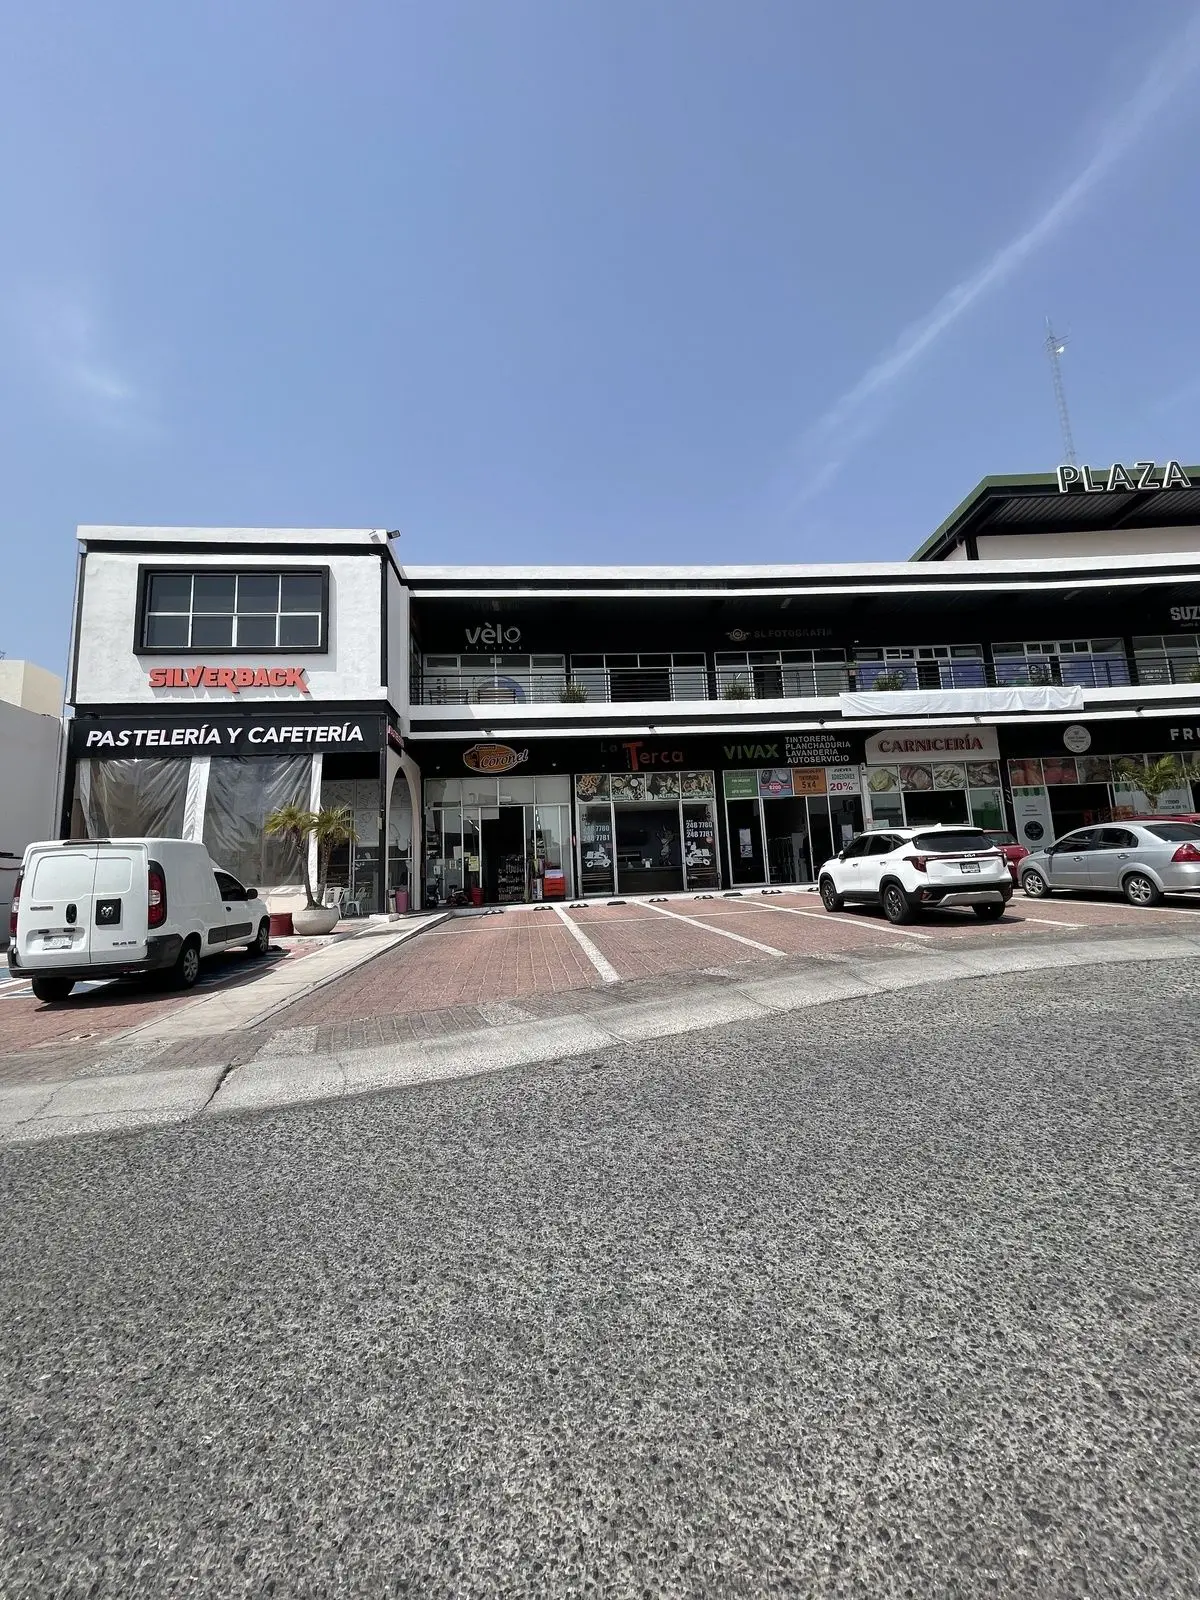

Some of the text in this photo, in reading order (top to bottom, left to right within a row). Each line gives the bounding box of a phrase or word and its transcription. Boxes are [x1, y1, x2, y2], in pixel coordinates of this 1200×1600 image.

[1056, 460, 1192, 493] PLAZA
[149, 665, 311, 694] SILVERBACK
[86, 724, 222, 747] PASTELERÍA
[227, 727, 244, 744] Y
[247, 722, 364, 743] CAFETERÍA
[784, 735, 836, 744] TINTORERIA
[878, 734, 983, 753] CARNICERÍA
[723, 743, 780, 760] VIVAX
[785, 741, 851, 750] PLANCHADURIA
[785, 748, 839, 757] LAVANDERIA
[480, 748, 529, 769] Coronel
[622, 740, 685, 771] Terca
[787, 754, 850, 764] AUTOSERVICIO
[830, 782, 853, 791] 20%
